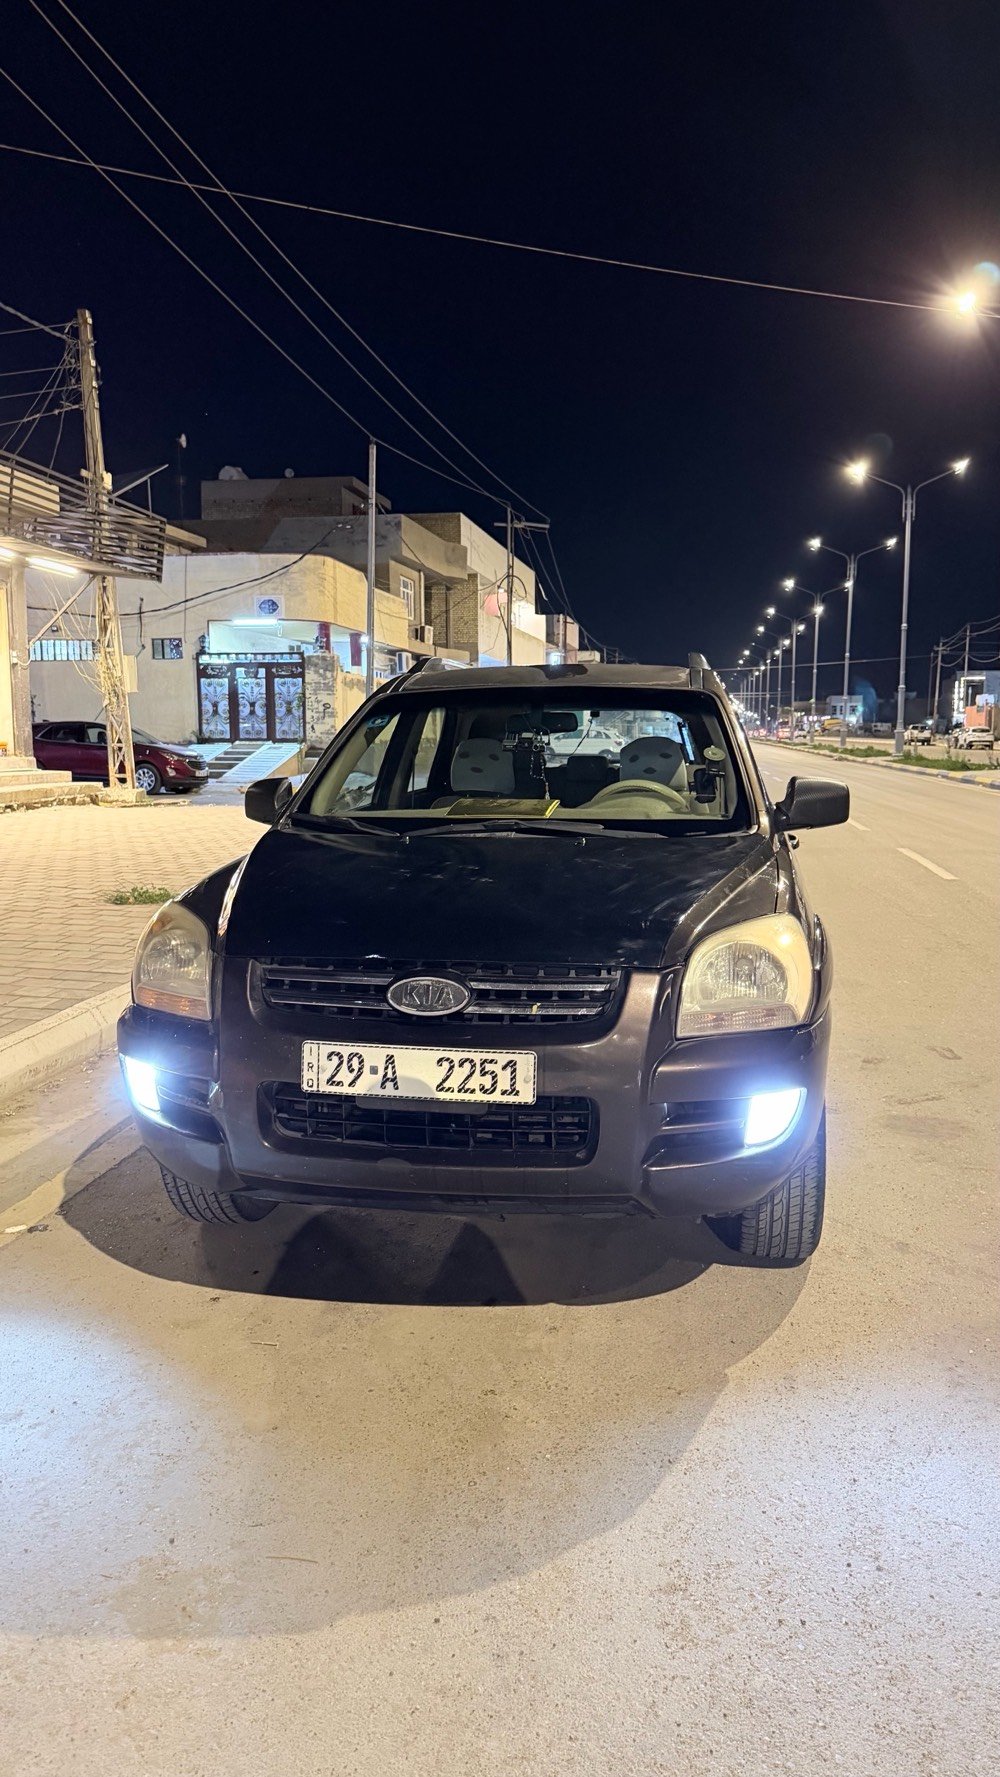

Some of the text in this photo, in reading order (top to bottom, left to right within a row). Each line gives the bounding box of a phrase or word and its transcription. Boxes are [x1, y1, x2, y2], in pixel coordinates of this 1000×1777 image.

[402, 983, 454, 1005] KIA
[326, 1050, 521, 1097] 29 A 2251
